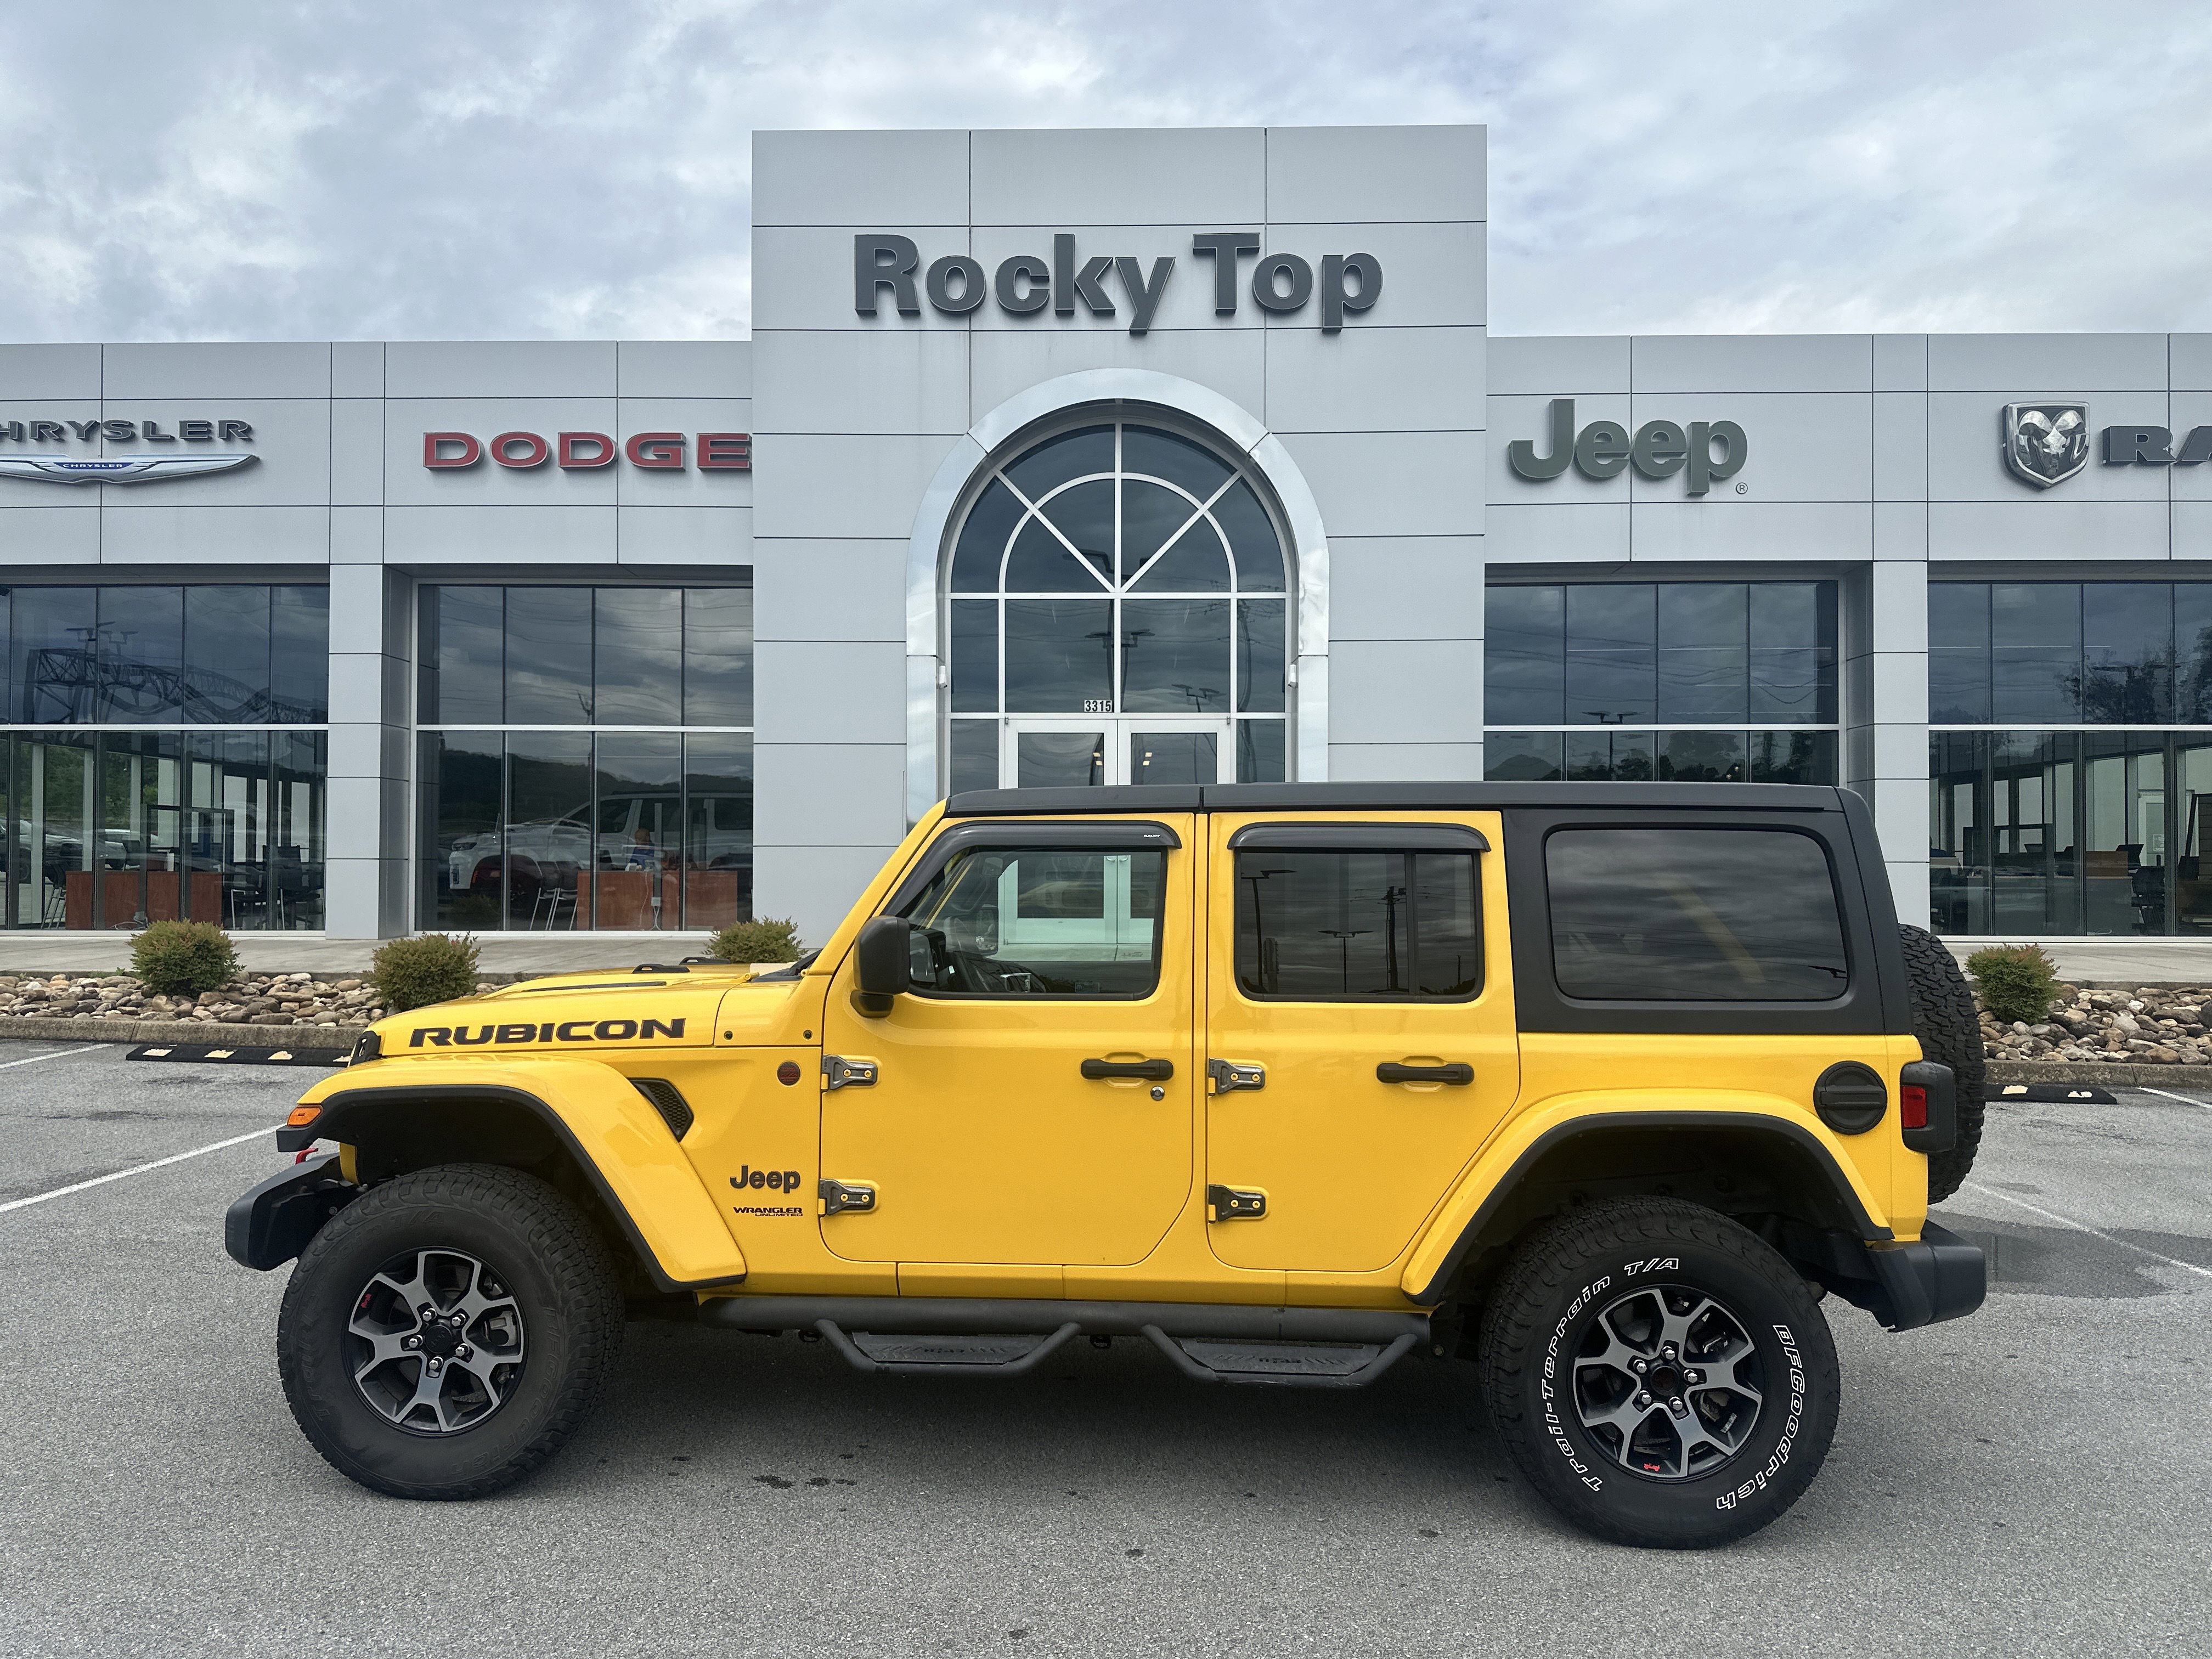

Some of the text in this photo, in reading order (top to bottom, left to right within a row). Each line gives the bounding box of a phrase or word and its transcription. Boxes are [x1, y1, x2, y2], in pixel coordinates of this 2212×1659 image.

[854, 232, 1384, 334] Rocky Top
[423, 431, 753, 471] DODGE
[1509, 399, 1748, 496] Jeep
[1085, 701, 1111, 712] 3315
[409, 1018, 686, 1047] RUBICON
[730, 1164, 801, 1194] Jeep
[1542, 1257, 1679, 1492] Trail-Terrain T/A
[1716, 1324, 1805, 1510] BFGoodrich
